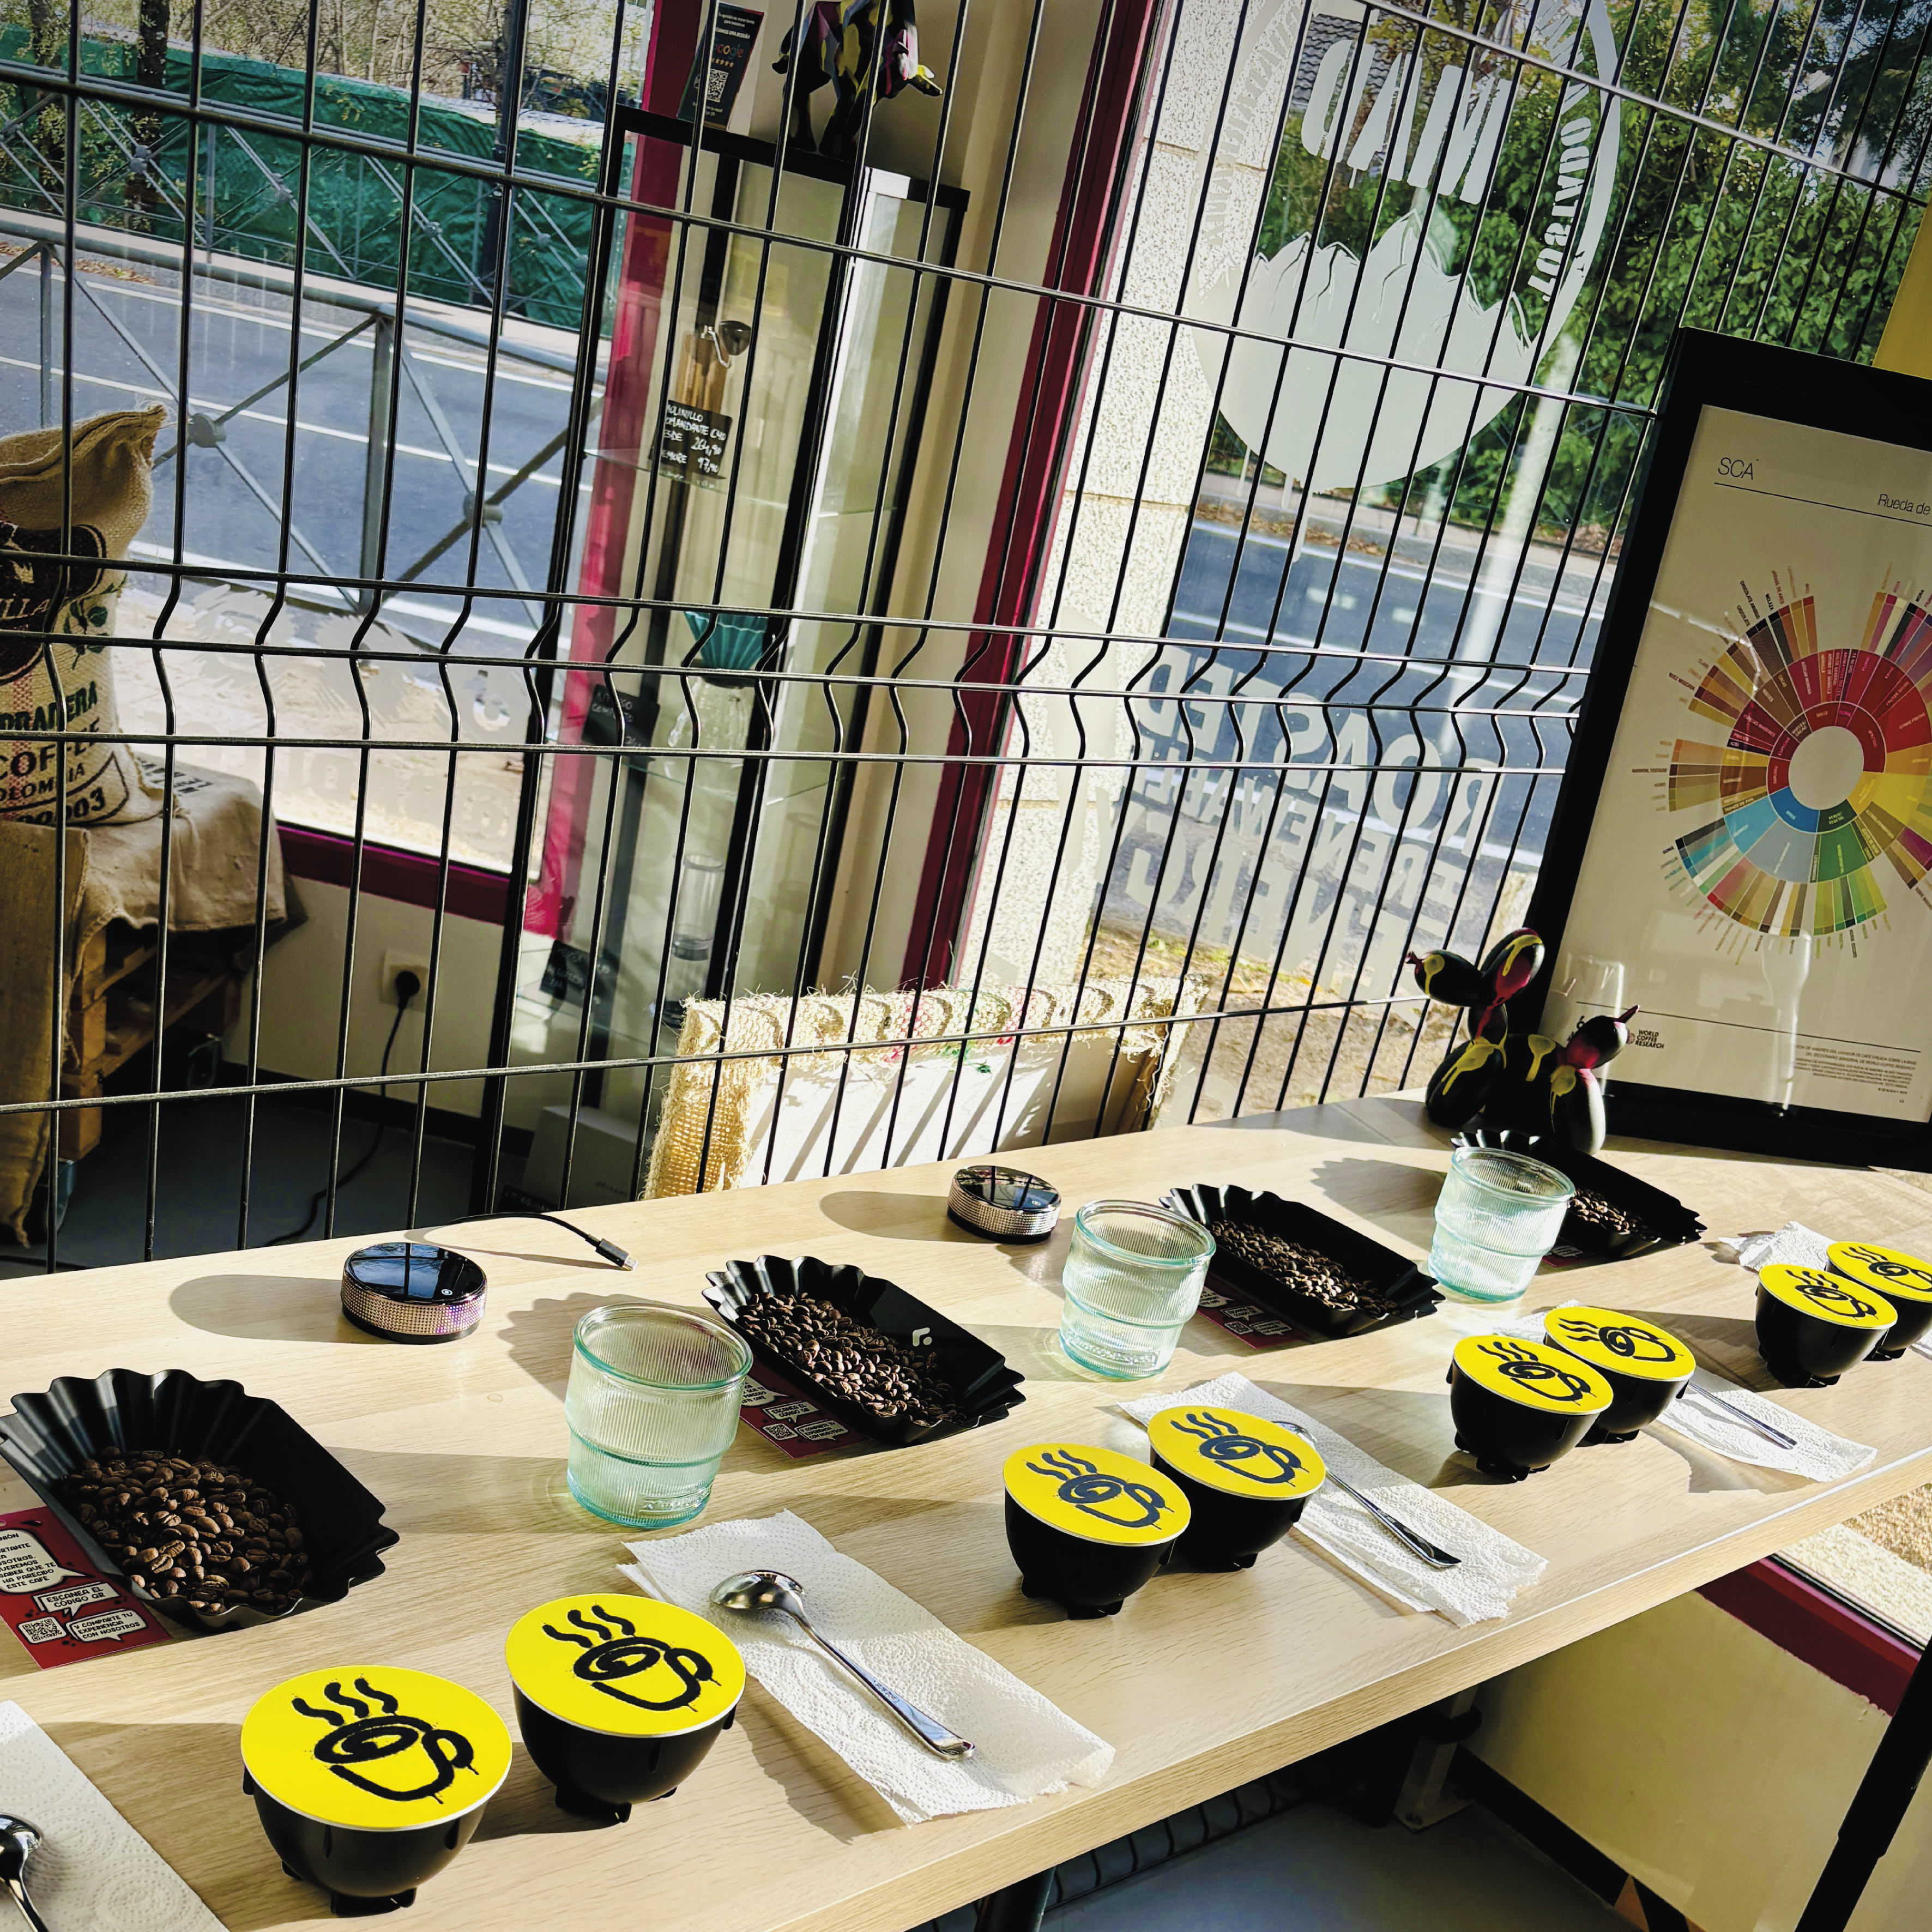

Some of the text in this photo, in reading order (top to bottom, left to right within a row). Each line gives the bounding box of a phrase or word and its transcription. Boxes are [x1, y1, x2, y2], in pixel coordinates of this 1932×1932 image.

[716, 44, 744, 59] oogle
[666, 417, 709, 436] OMANDANTE
[1877, 493, 1931, 516] Rueda de
[1639, 1029, 1659, 1037] WORLD
[1635, 1040, 1665, 1049] RESEARCH
[0, 1543, 31, 1553] RTANTE
[0, 1560, 38, 1572] UEREMOS
[16, 1569, 54, 1580] PARECIDO
[6, 1575, 50, 1589] ESTE CAFÉ
[46, 1589, 90, 1603] ESCANEA
[54, 1595, 89, 1608] CÓDIGO
[78, 1620, 124, 1634] EXPERIENCIA
[82, 1615, 121, 1628] COMPARTE
[100, 1622, 141, 1634] NOSOTROS
